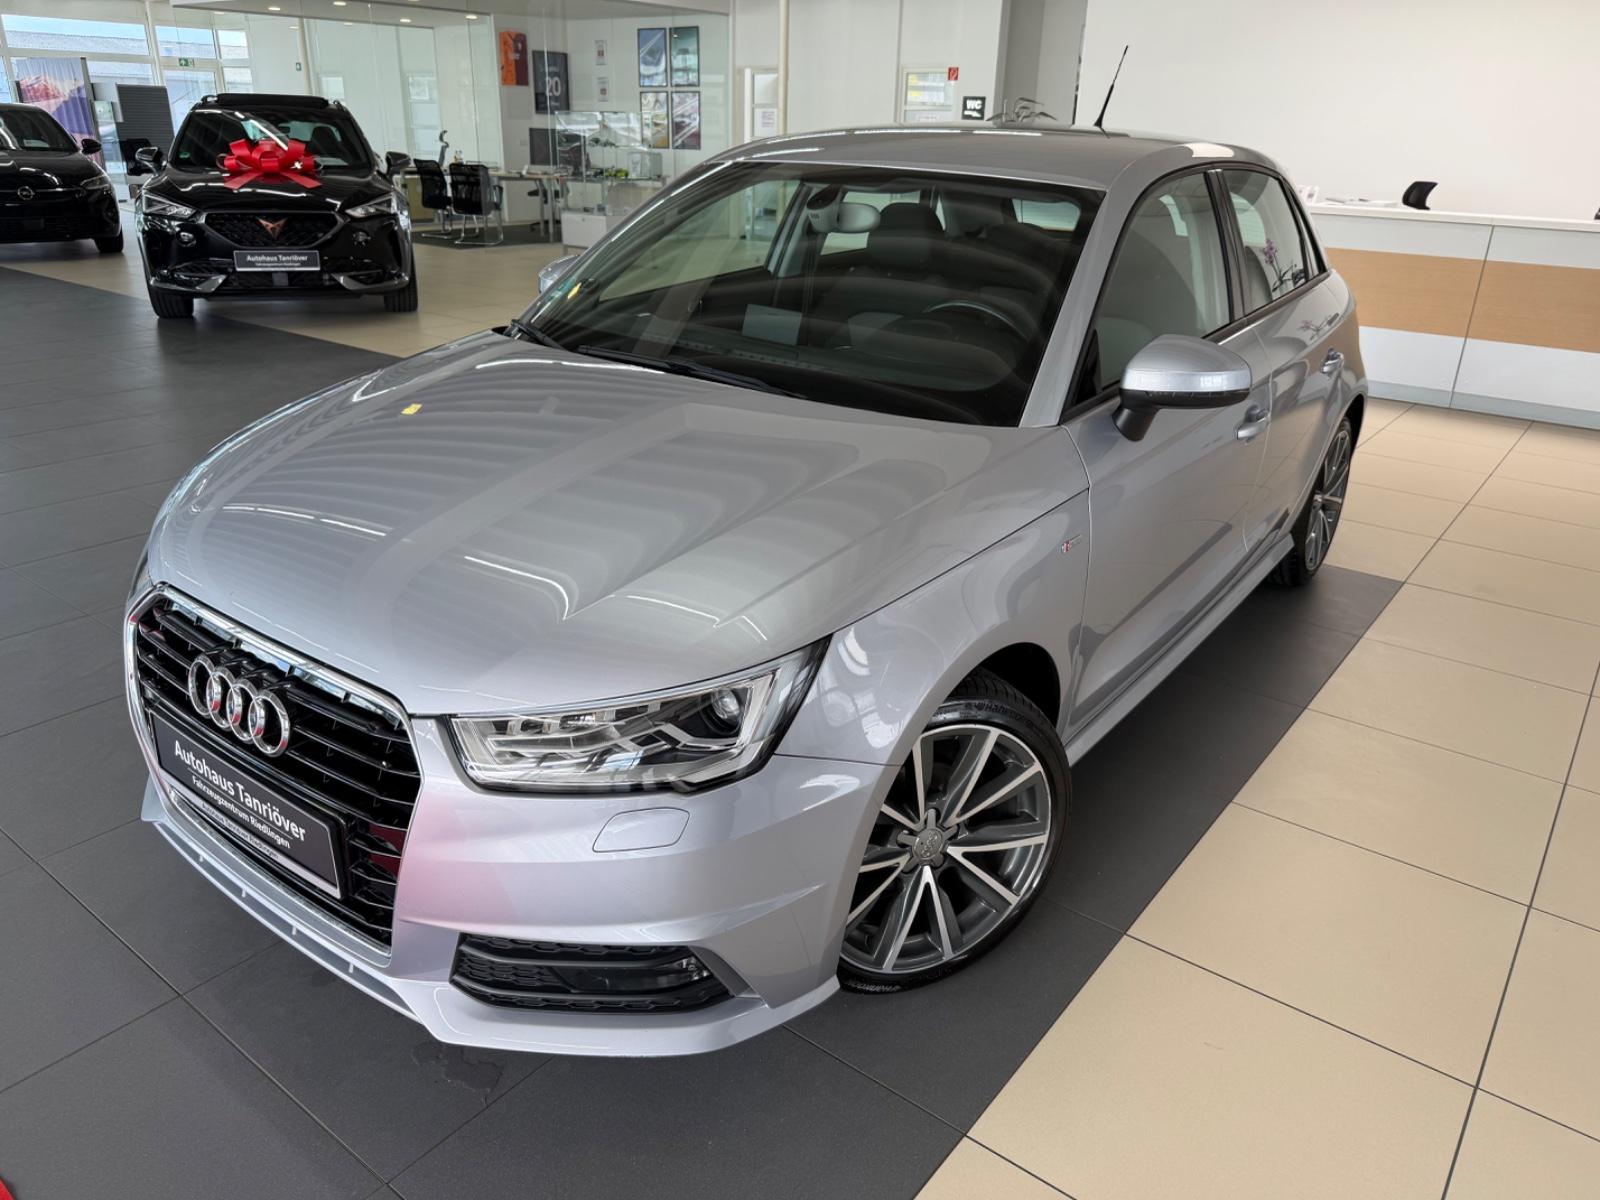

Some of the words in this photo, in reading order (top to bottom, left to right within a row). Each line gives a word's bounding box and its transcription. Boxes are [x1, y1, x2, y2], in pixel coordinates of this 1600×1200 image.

[966, 99, 983, 110] WC
[246, 254, 277, 262] Autohaus
[174, 740, 235, 796] Autohaus
[235, 782, 306, 841] Tanriöver
[192, 775, 253, 823] Fahrzeugzentrum
[250, 815, 291, 849] Riedlingen
